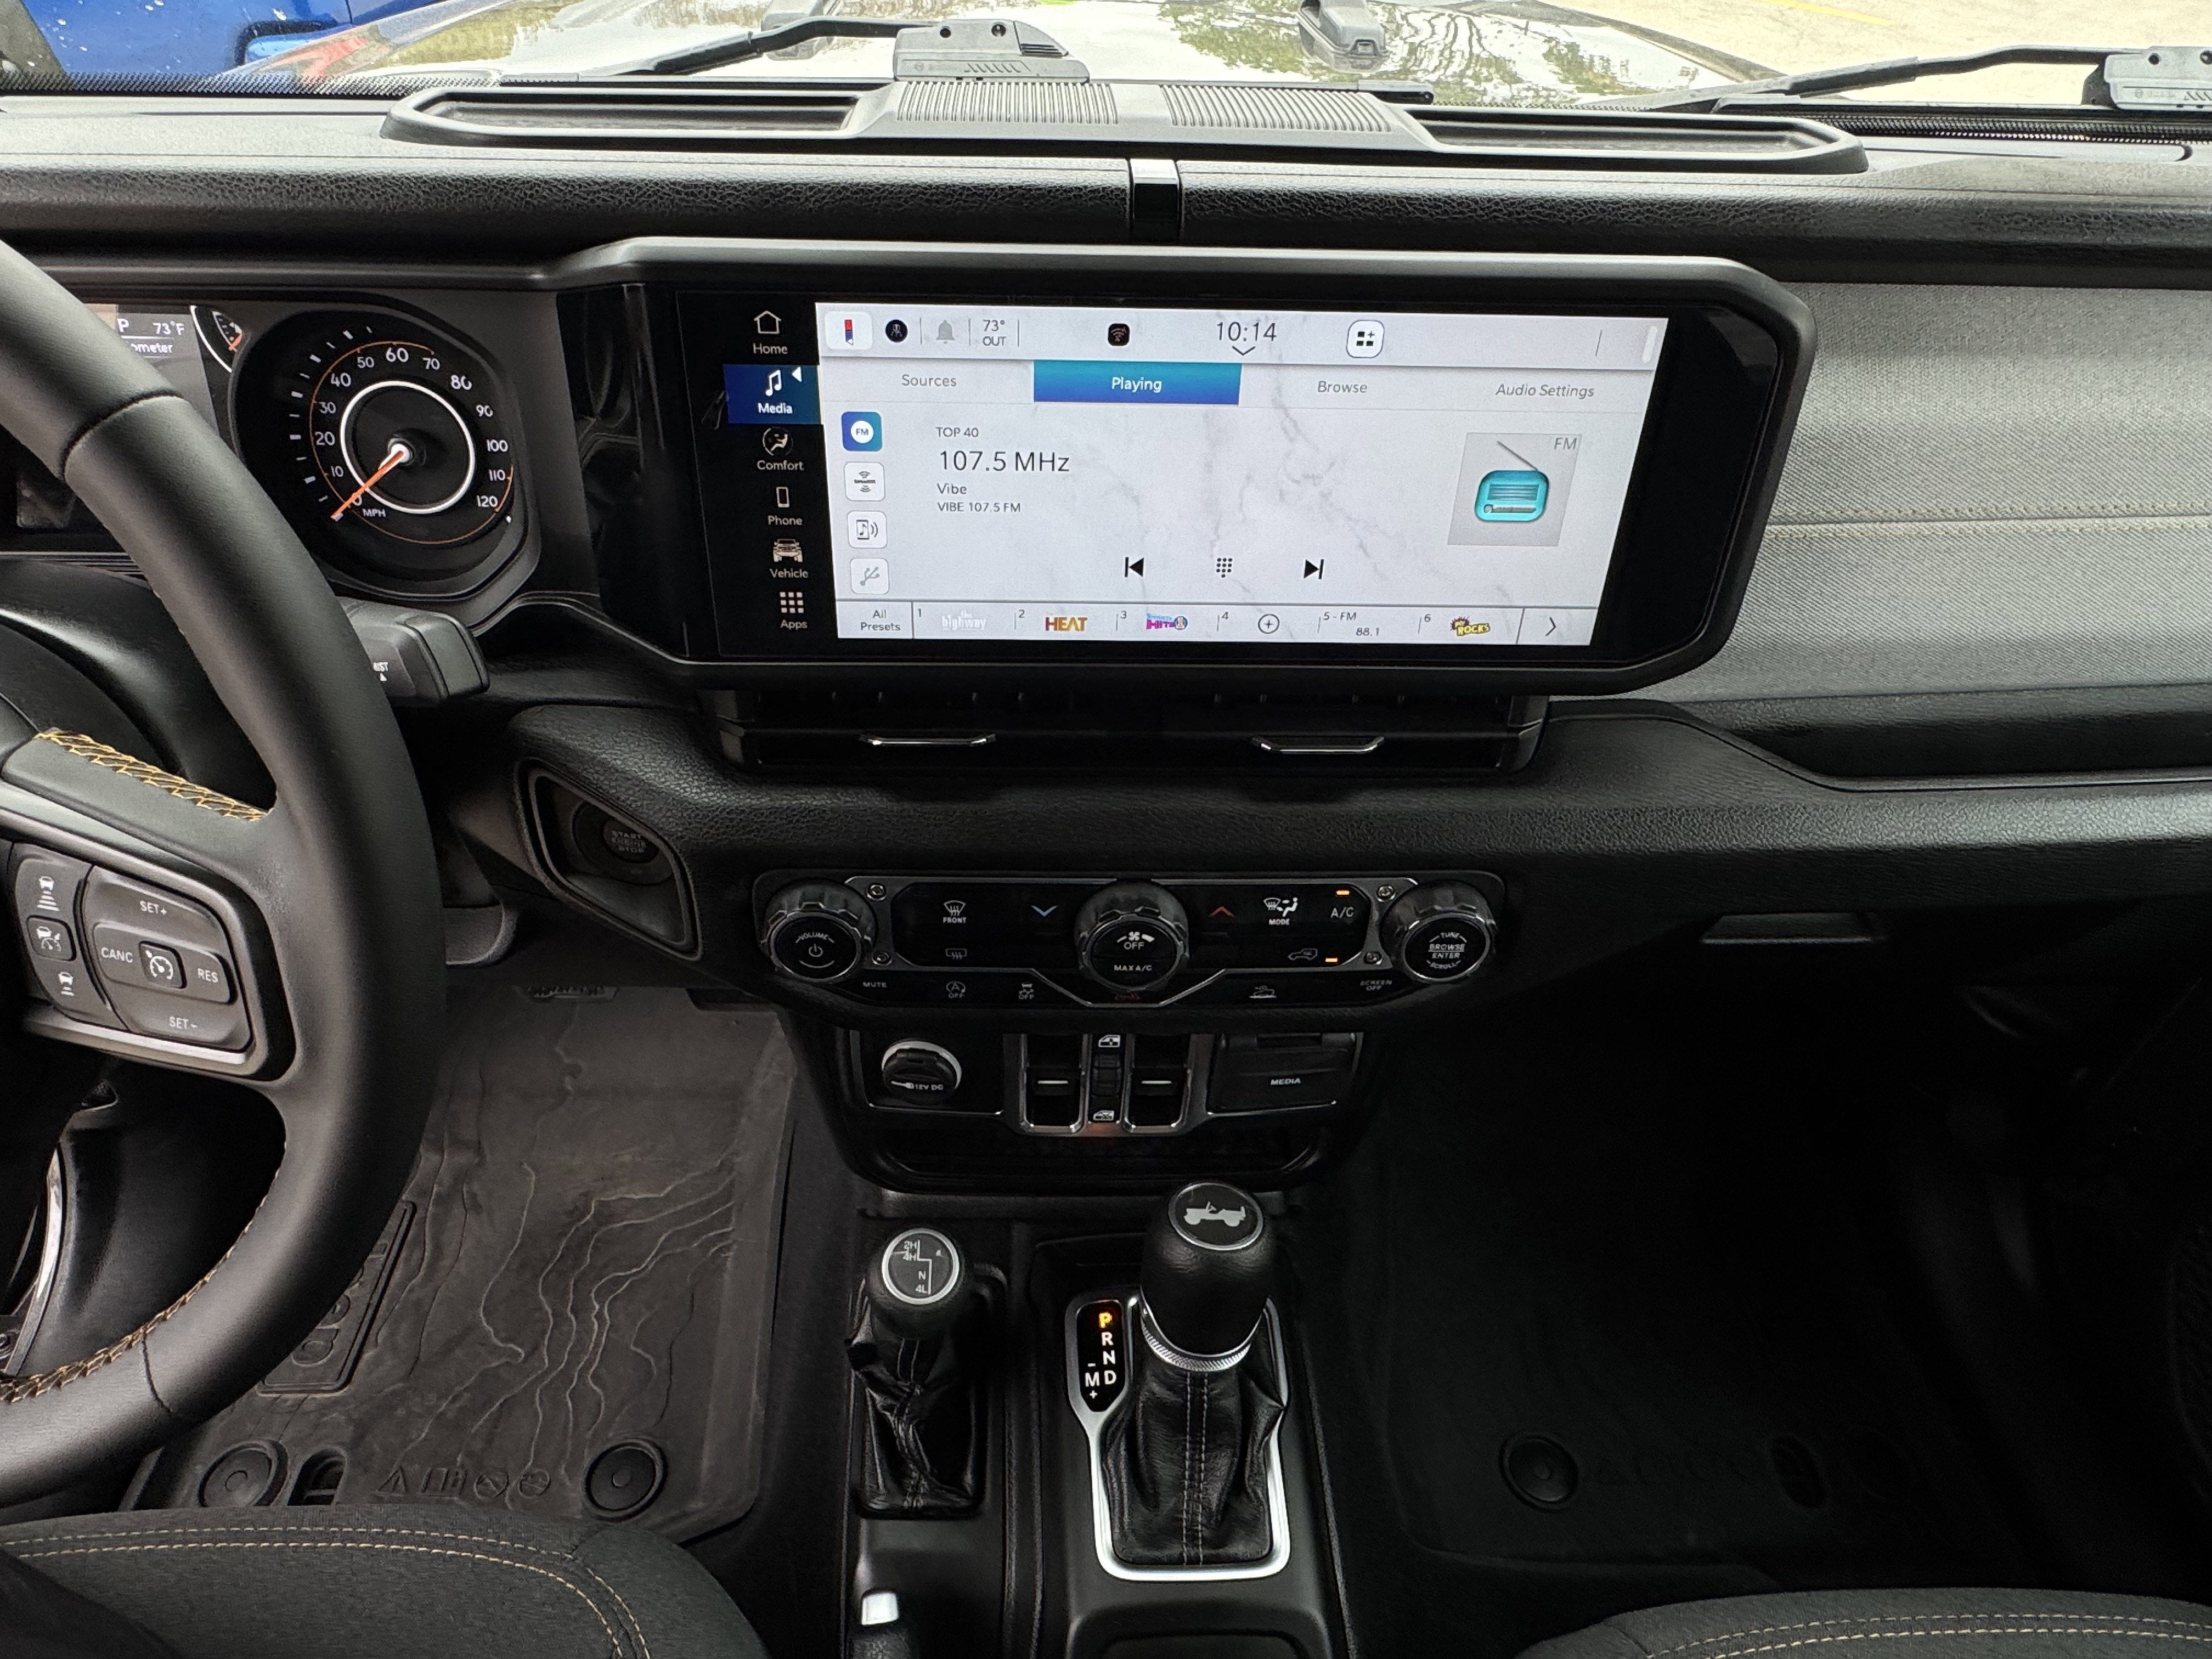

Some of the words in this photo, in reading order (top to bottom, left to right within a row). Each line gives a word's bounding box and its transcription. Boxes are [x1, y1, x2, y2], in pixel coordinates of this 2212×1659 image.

[117, 318, 129, 332] P
[983, 319, 1005, 332] 73°
[1217, 322, 1277, 342] 10:14
[983, 336, 1006, 347] OUT
[753, 343, 788, 354] Home
[385, 348, 409, 363] 60
[357, 357, 375, 368] 50
[422, 357, 440, 370] 70
[331, 373, 351, 387] 40
[450, 375, 472, 391] 80
[901, 375, 957, 387] Sources
[1111, 376, 1162, 392] Playing
[1318, 381, 1367, 393] Browse
[1496, 383, 1536, 396] Audio
[1539, 385, 1594, 399] Settings
[319, 402, 336, 414] 30
[476, 405, 493, 417] 90
[758, 403, 793, 414] Media
[314, 432, 335, 445] 20
[935, 427, 961, 437] TOP
[964, 427, 979, 438] 40
[486, 439, 508, 452] 100
[1554, 437, 1577, 450] FM
[757, 460, 804, 471] Comfort
[940, 450, 1007, 472] 107.5
[1015, 452, 1070, 472] MHz
[331, 466, 343, 477] 10
[488, 470, 505, 481] 110
[937, 483, 967, 495] Vibe
[476, 495, 498, 507] 120
[938, 502, 964, 512] VIBE
[969, 502, 1000, 512] 107.5
[1003, 503, 1021, 512] FM
[363, 508, 386, 517] MPH
[768, 515, 803, 526] Phone
[770, 568, 809, 579] Vehicle
[872, 609, 887, 619] All
[918, 608, 922, 617] 1
[1019, 610, 1025, 618] 2
[1120, 611, 1127, 619] 3
[1221, 611, 1228, 620] 4
[1323, 612, 1330, 620] 5
[1340, 612, 1357, 620] FM
[1424, 614, 1431, 622] 6
[780, 620, 808, 630] Apps
[860, 622, 901, 631] Presets
[1045, 617, 1088, 631] HEAT
[1356, 628, 1379, 636] 88.1
[1330, 907, 1354, 919] A/C
[101, 947, 133, 964] CANC
[198, 968, 218, 983] RES
[904, 1240, 917, 1250] 2H
[918, 1271, 926, 1280] N
[915, 1284, 928, 1294] 4L
[1098, 1312, 1112, 1328] P
[1102, 1332, 1113, 1346] R
[1103, 1351, 1116, 1364] N
[1085, 1372, 1099, 1387] M
[1104, 1371, 1117, 1385] D
